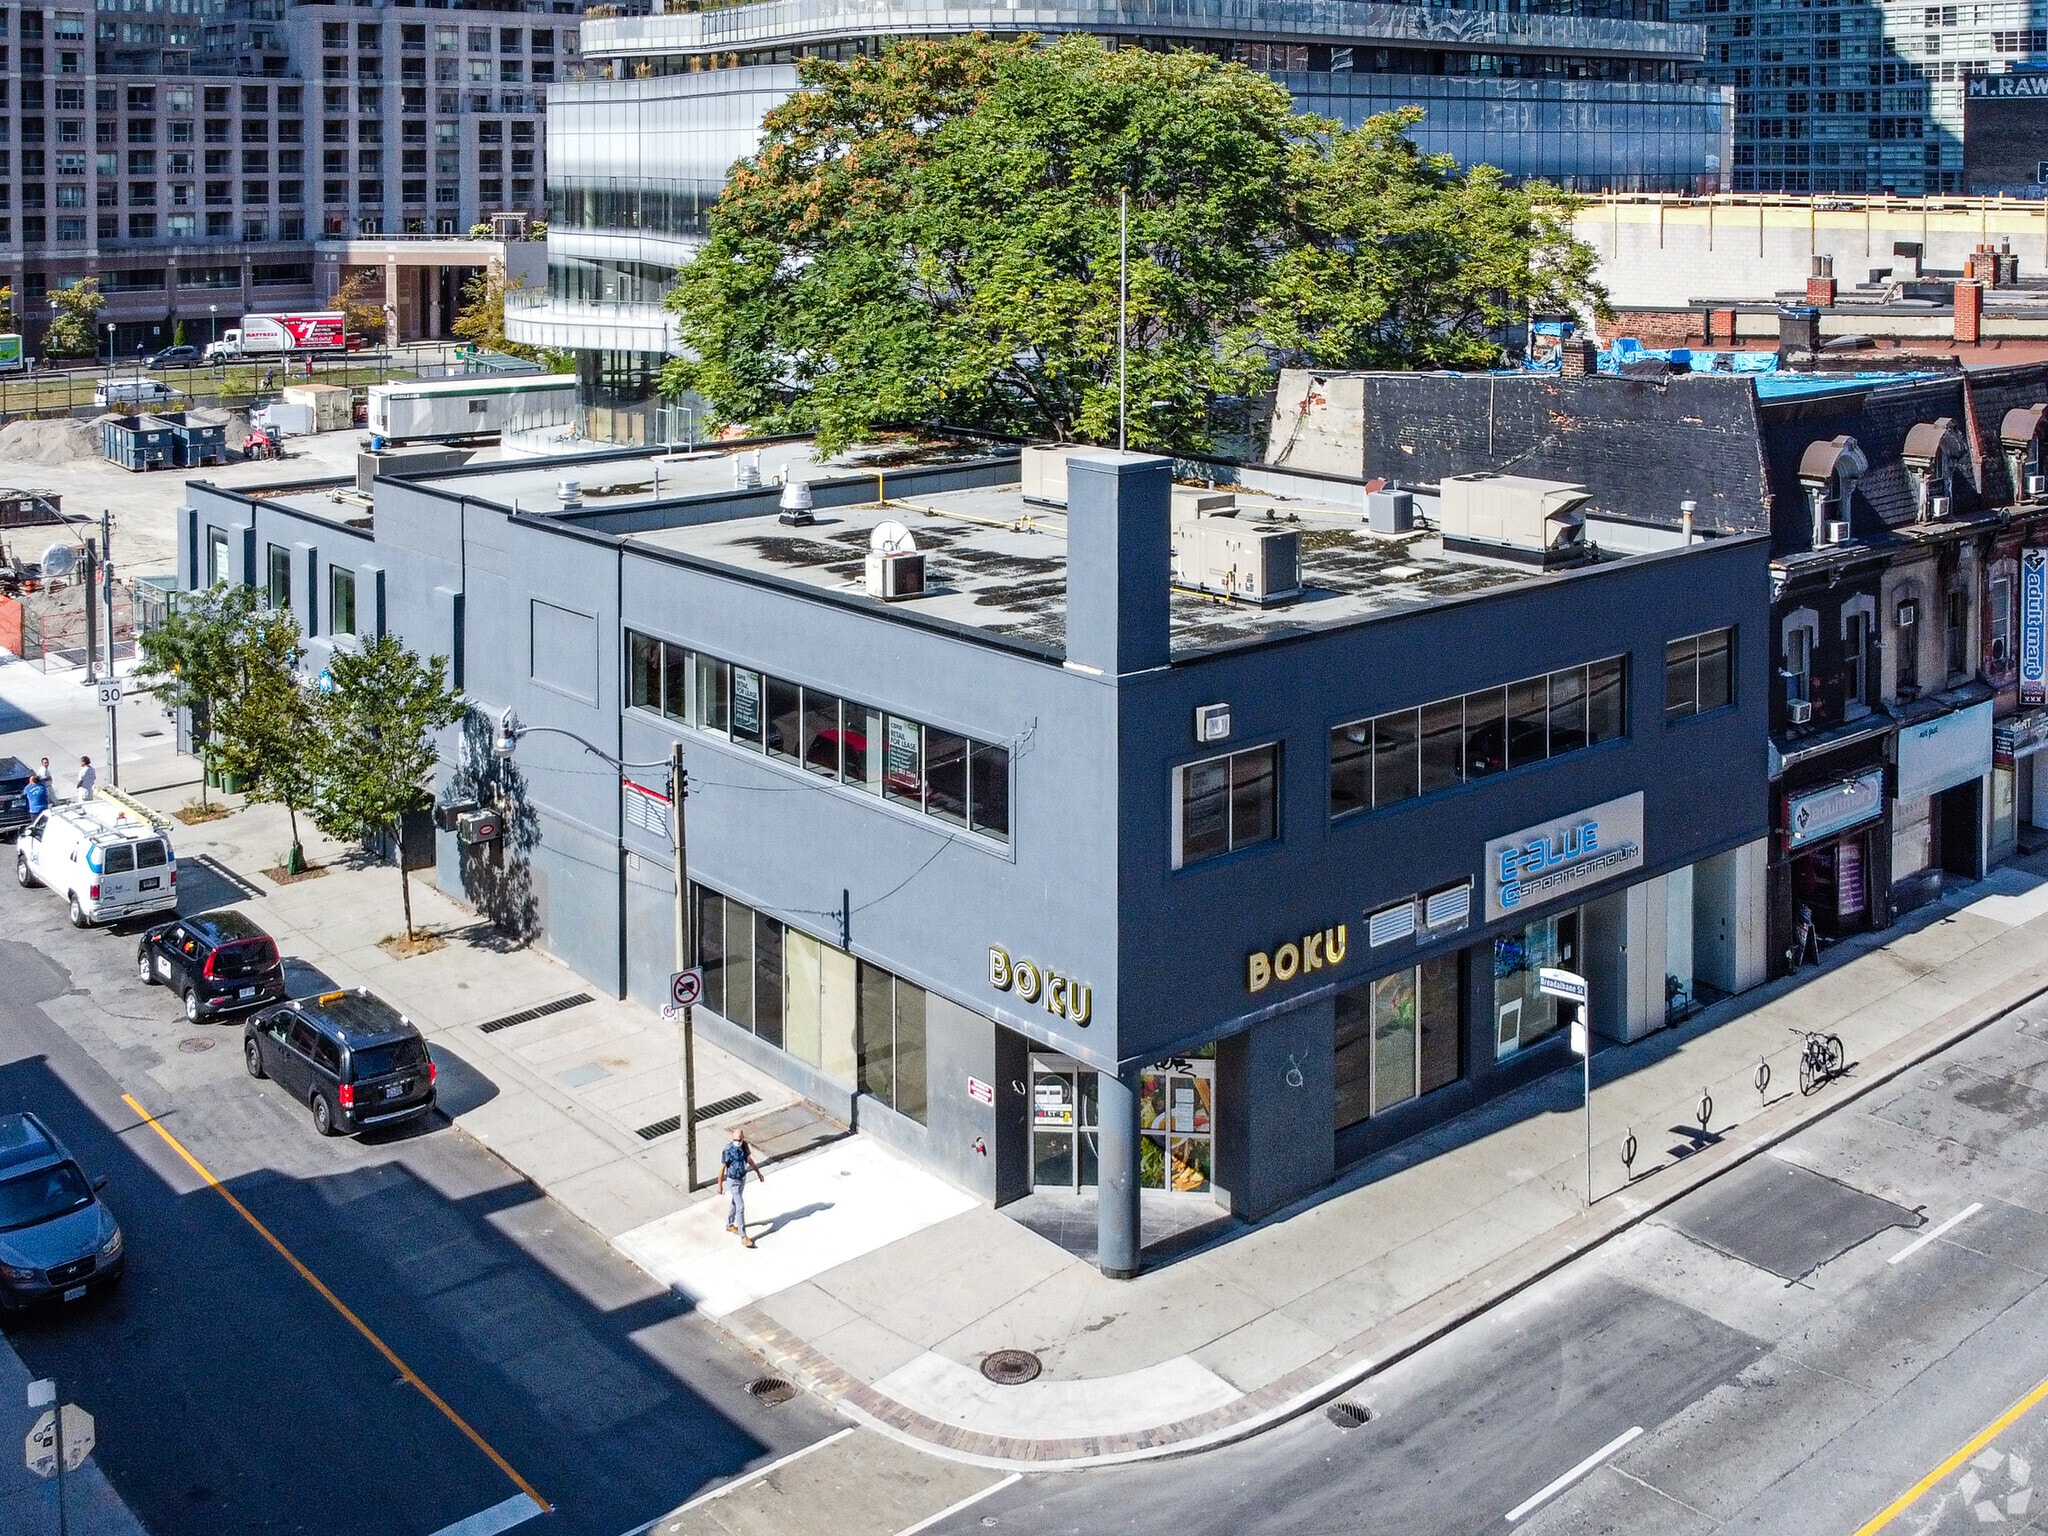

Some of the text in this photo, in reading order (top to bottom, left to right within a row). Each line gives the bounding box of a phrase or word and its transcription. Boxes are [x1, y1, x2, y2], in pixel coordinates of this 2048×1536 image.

[101, 688, 120, 702] 30
[1501, 822, 1599, 882] E-BLUE
[988, 946, 1091, 1024] BOKU
[1249, 924, 1346, 993] BOKU
